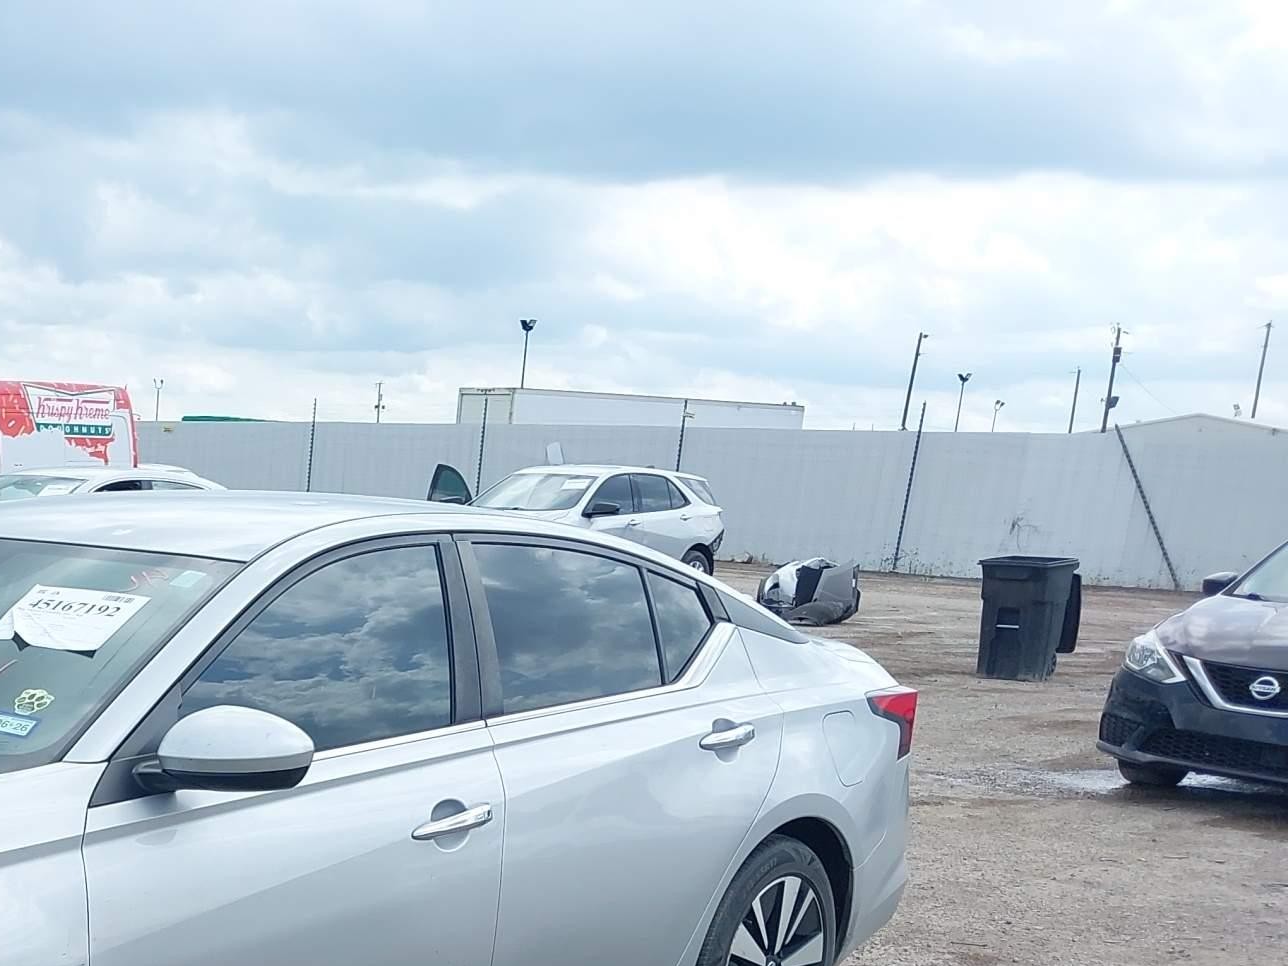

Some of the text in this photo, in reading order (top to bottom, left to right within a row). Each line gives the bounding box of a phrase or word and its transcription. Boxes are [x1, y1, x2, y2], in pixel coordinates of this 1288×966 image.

[36, 396, 110, 422] Krispy Kreme
[29, 598, 120, 617] 45167192
[11, 722, 30, 732] 26
